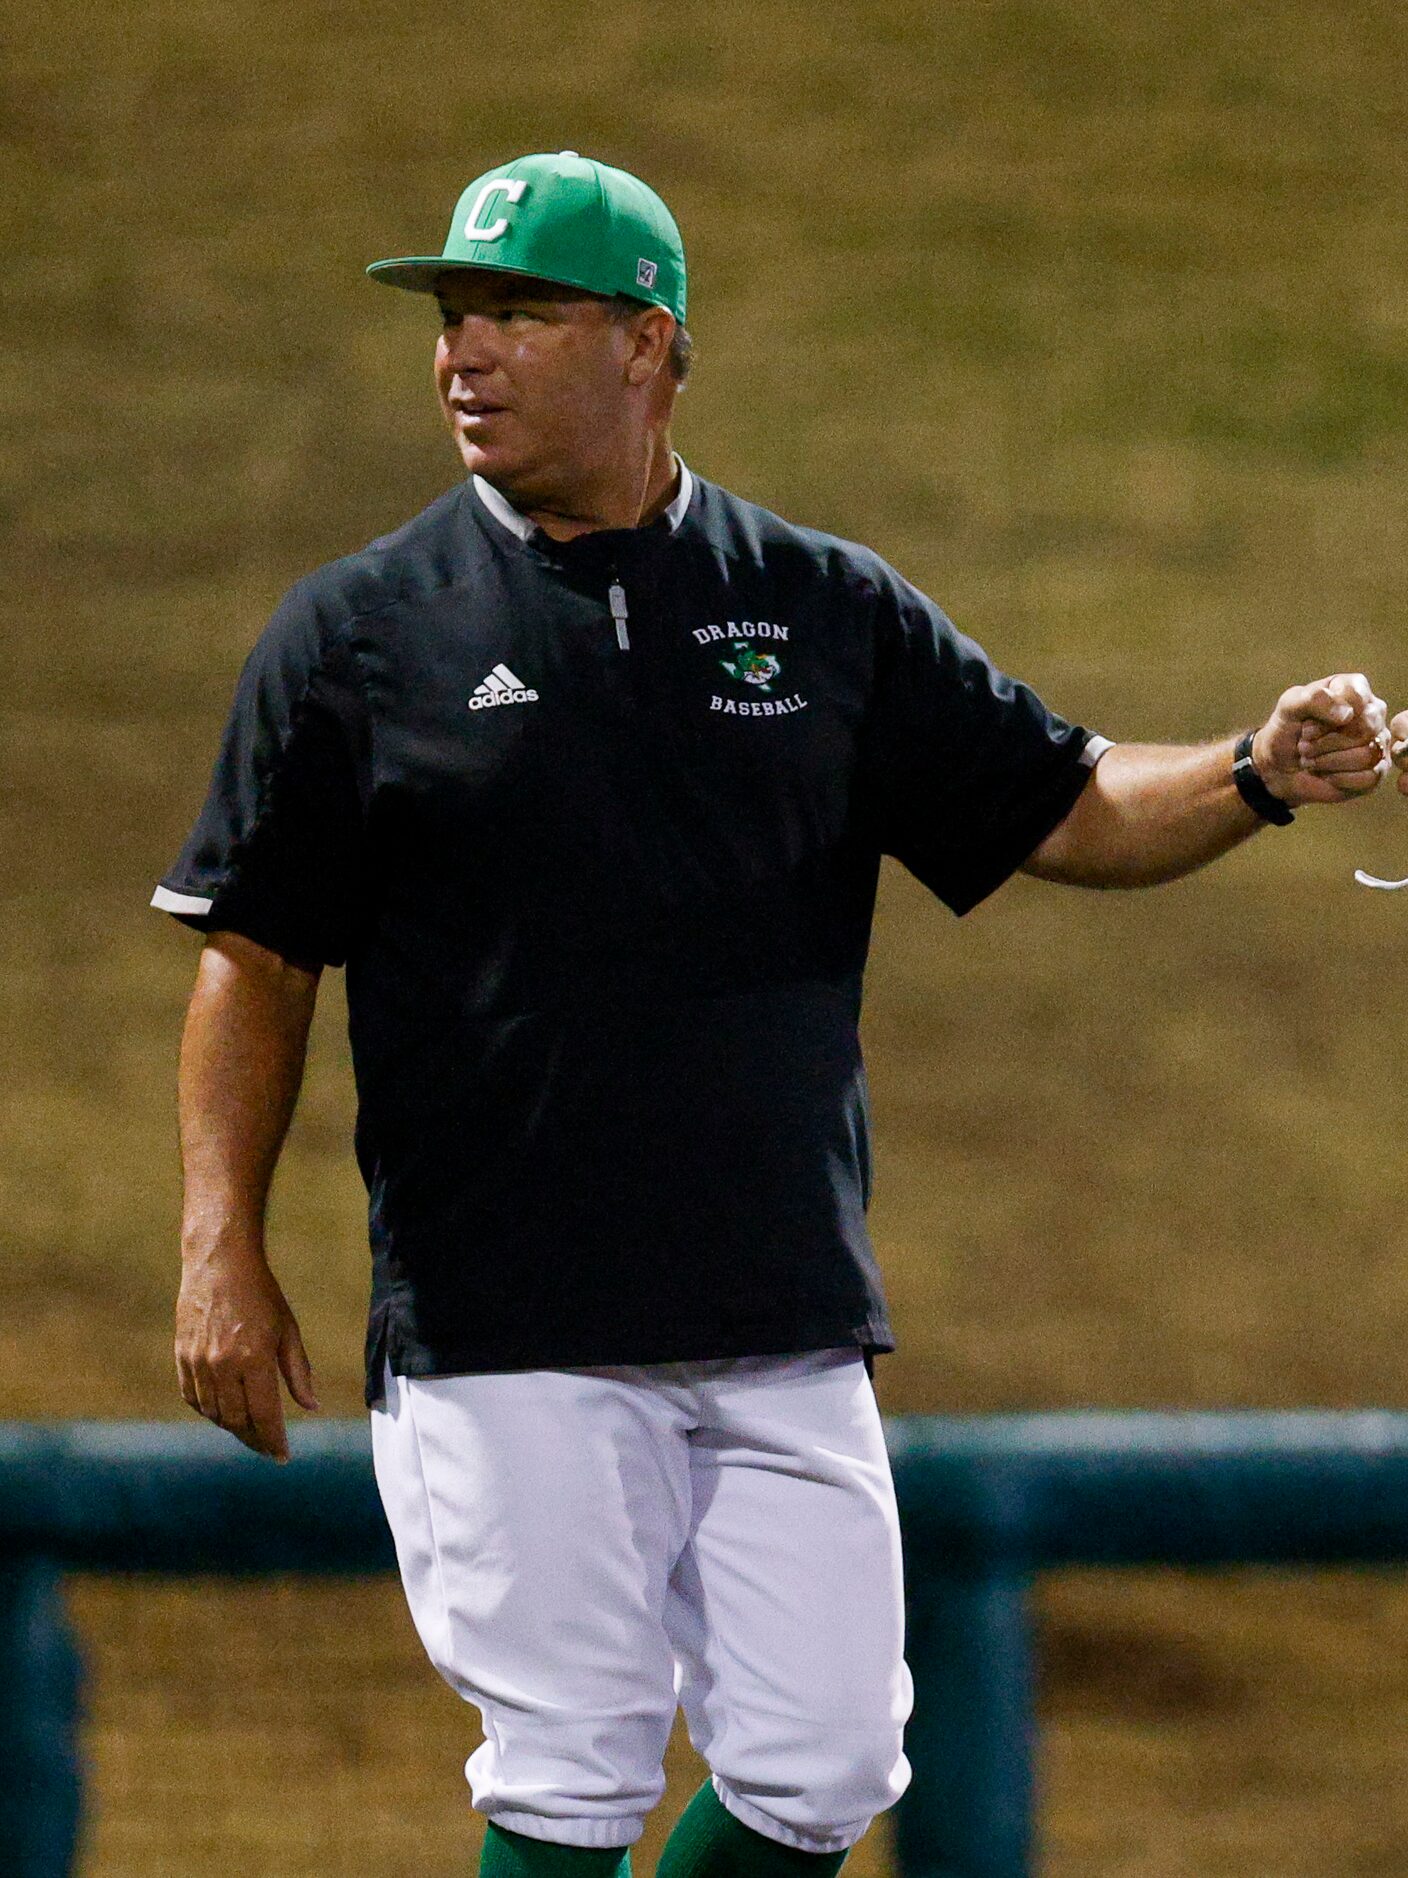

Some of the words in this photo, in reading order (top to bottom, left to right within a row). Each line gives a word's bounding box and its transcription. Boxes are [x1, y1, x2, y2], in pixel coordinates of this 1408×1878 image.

[465, 178, 527, 241] C
[692, 621, 789, 645] DRAGON
[468, 687, 539, 710] adidas
[709, 694, 807, 717] BASEBALL
